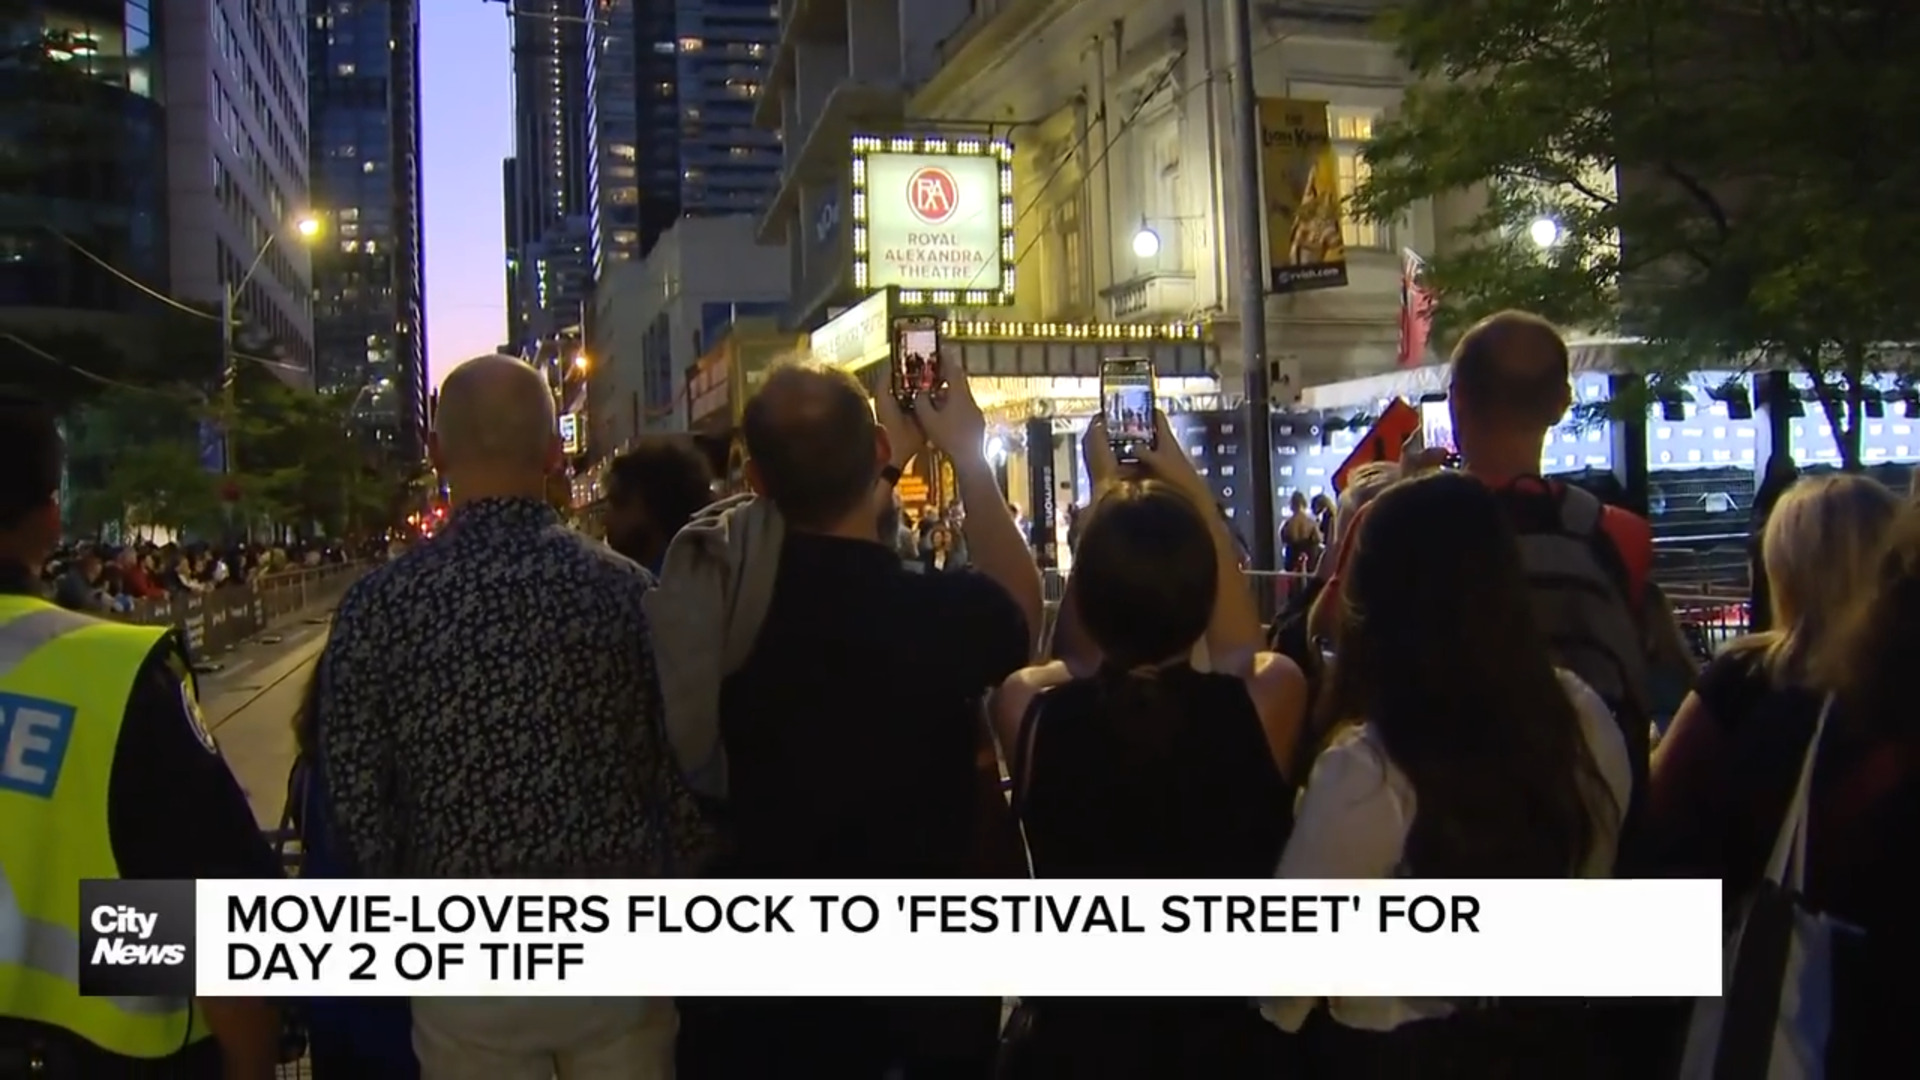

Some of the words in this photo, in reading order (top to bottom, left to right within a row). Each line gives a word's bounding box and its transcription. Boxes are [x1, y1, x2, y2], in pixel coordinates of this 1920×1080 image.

[907, 232, 958, 246] ROYAL
[884, 249, 984, 262] ALEXANDRA
[899, 265, 971, 279] THEATRE
[536, 259, 547, 309] HYATT
[0, 704, 61, 785] E
